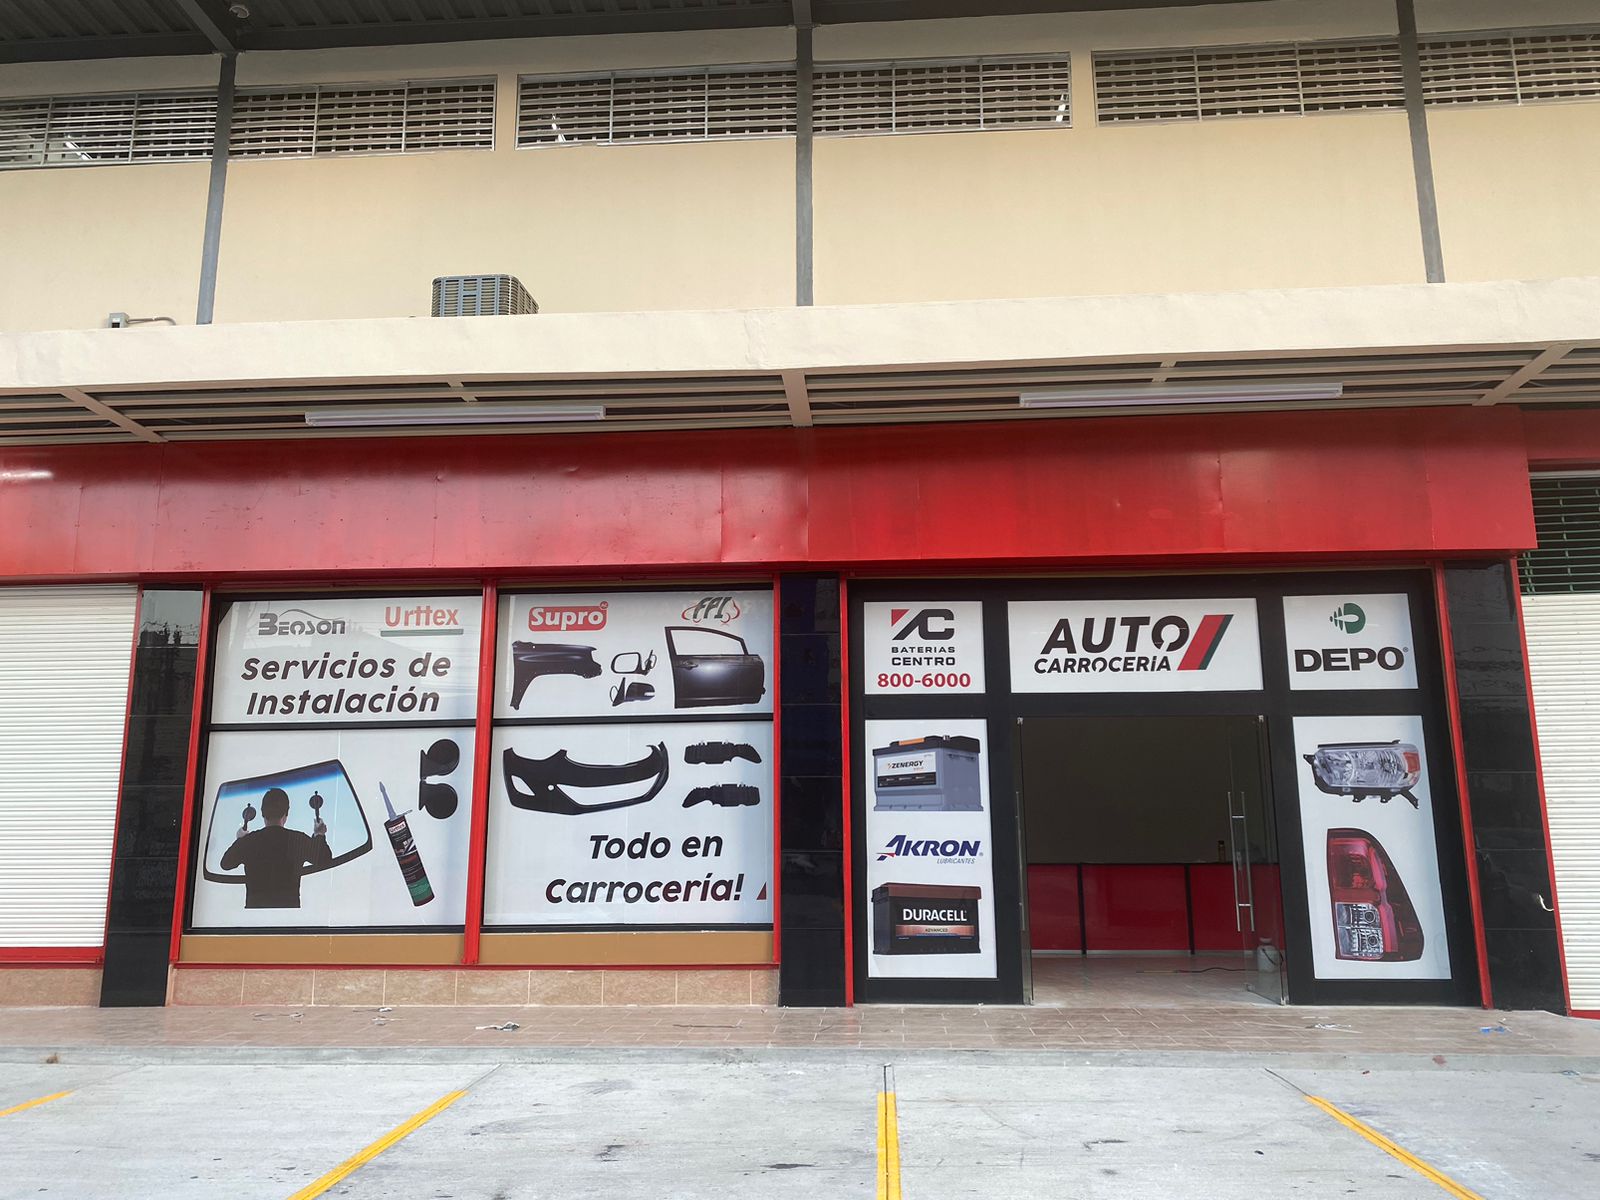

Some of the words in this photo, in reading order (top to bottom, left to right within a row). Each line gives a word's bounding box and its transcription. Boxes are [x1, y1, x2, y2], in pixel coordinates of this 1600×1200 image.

[384, 605, 460, 628] Urttex
[530, 607, 604, 631] Supro
[1040, 615, 1190, 655] AUTO
[891, 646, 956, 654] BATERIAS
[891, 656, 957, 666] CENTRO
[1294, 646, 1405, 673] DEPO
[240, 651, 397, 681] Servicios
[408, 652, 452, 678] de
[877, 672, 972, 688] 800-6000
[246, 685, 440, 715] Instalación
[892, 760, 924, 769] ZENERGY
[589, 831, 671, 860] Todo
[681, 835, 723, 858] en
[877, 834, 982, 862] AKRON
[936, 857, 977, 865] LUBRICANTES
[545, 872, 745, 904] Carrocería!
[902, 908, 968, 922] DURACELL
